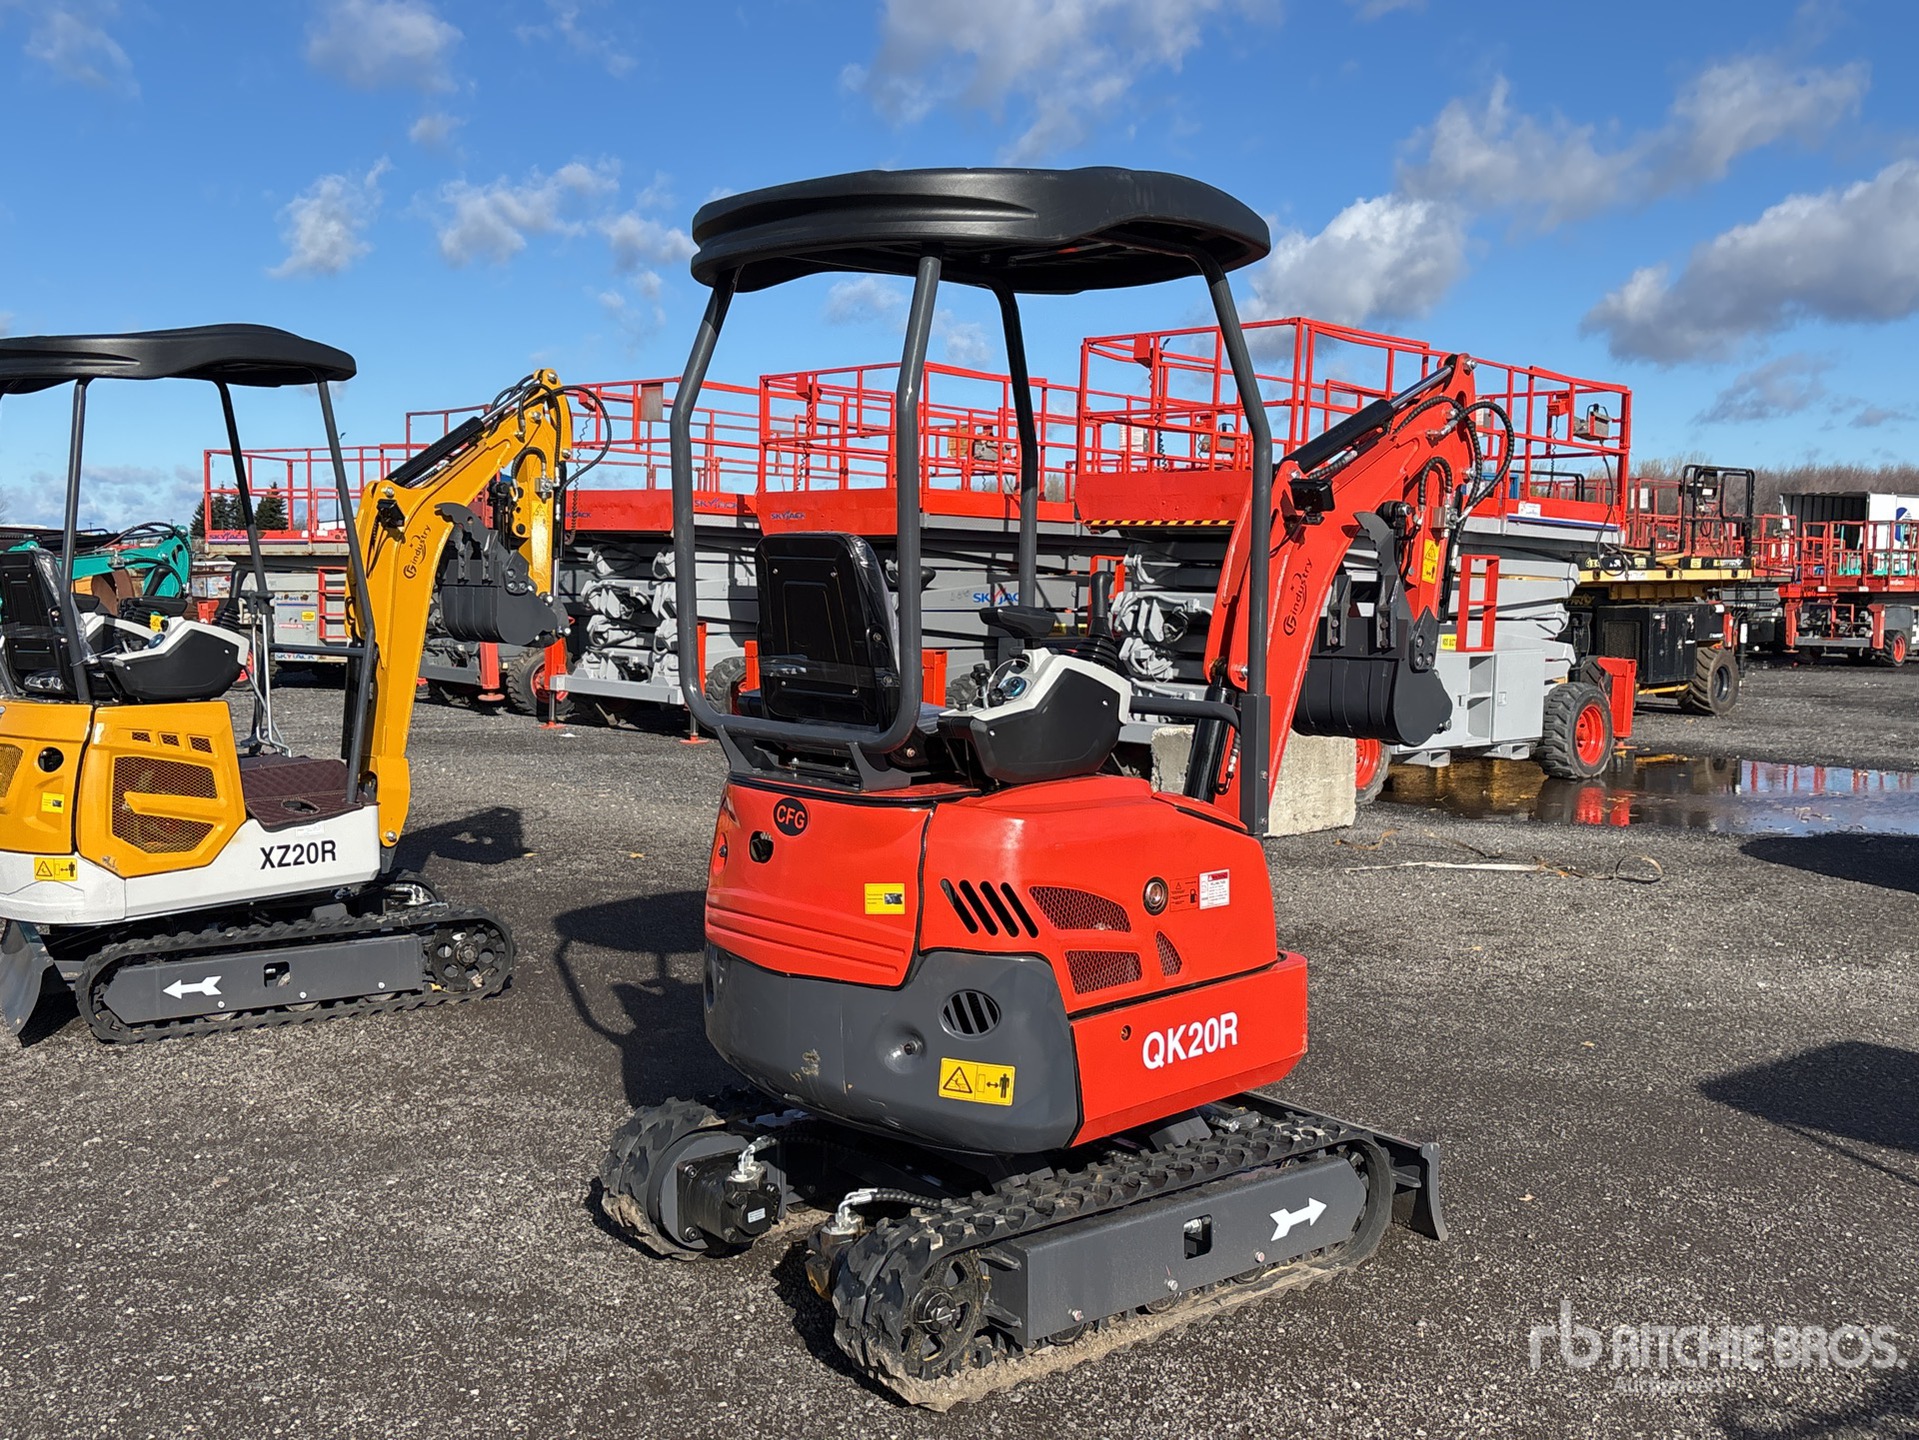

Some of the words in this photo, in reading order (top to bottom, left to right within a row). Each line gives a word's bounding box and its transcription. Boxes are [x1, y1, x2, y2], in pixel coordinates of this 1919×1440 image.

[973, 586, 1019, 605] SKYJAC
[776, 805, 806, 829] CFG
[260, 840, 337, 870] XZ20R
[1142, 1011, 1239, 1070] QK20R
